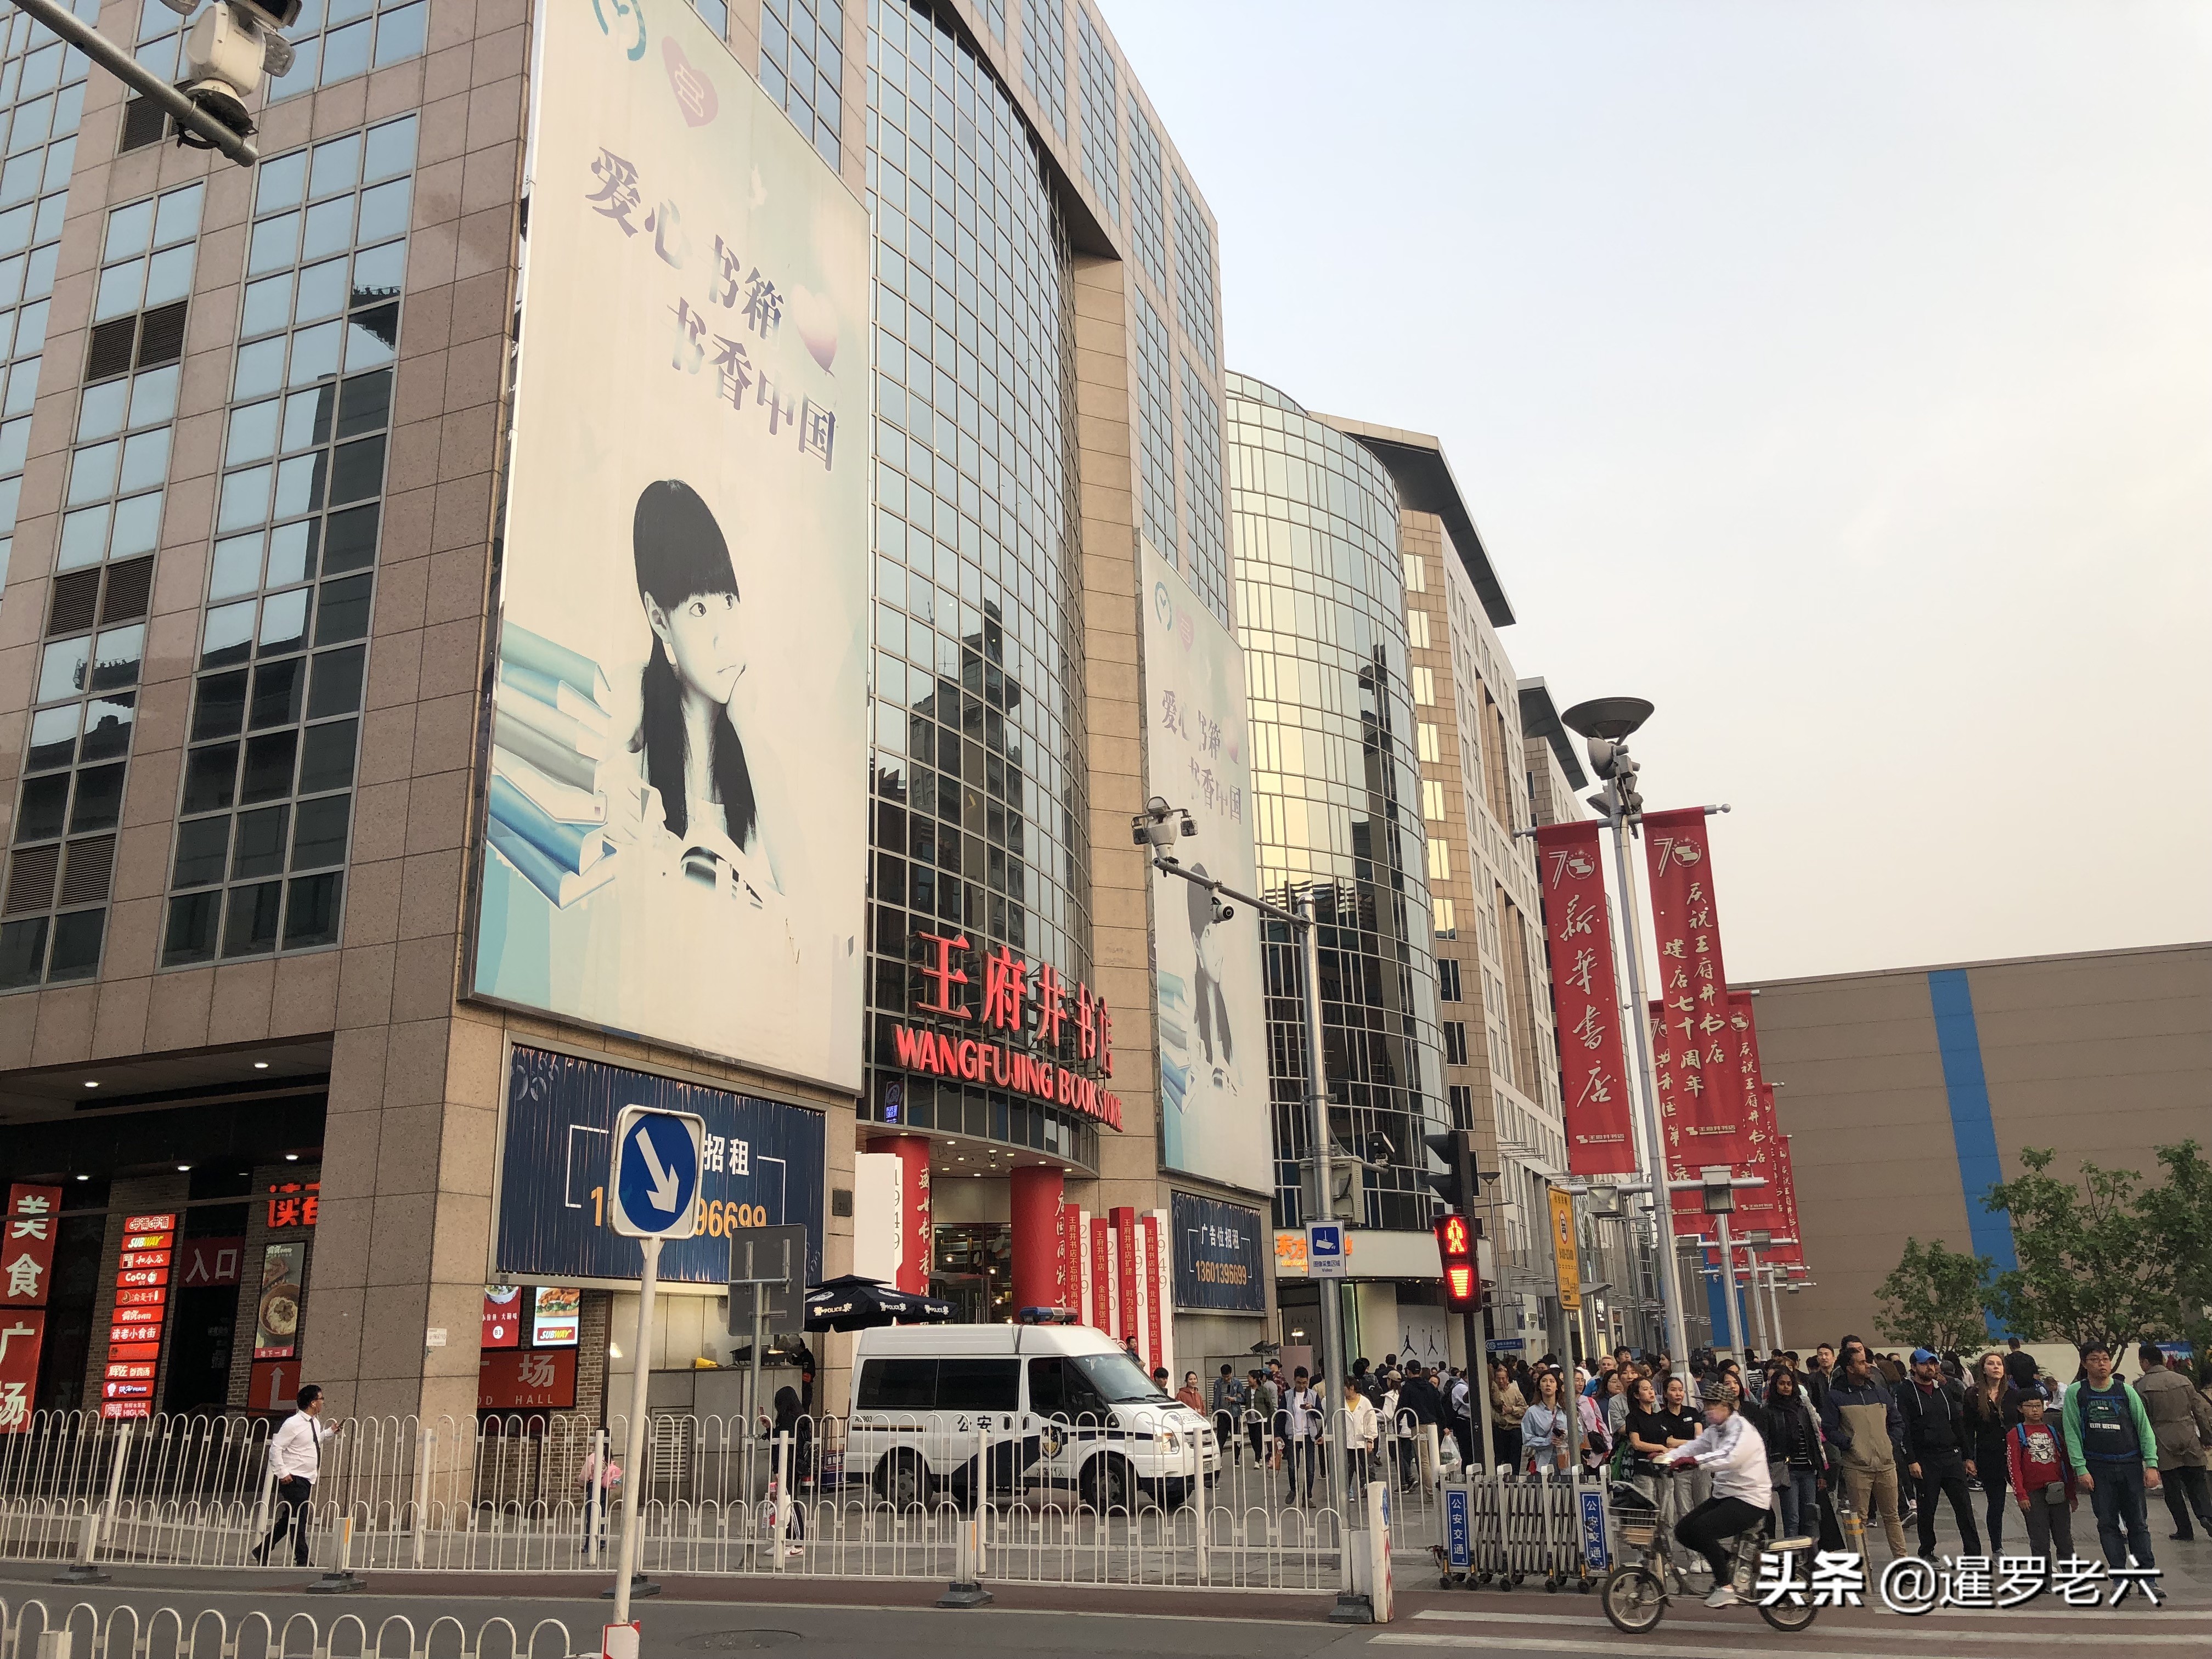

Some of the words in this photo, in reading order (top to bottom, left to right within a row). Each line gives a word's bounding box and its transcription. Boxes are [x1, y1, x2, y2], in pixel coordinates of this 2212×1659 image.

[1686, 882, 1725, 1064] 庆祝王府井书店
[914, 930, 1114, 1079] 王府井书店
[1662, 939, 1705, 1098] 建店七十周年
[891, 1023, 1054, 1099] WANGFUJING
[1057, 1066, 1124, 1133] BOOKSTORE
[127, 1235, 164, 1249] SUBWAY
[1201, 1223, 1240, 1250] 广告位招租
[185, 1247, 238, 1283] 入口
[1069, 1216, 1079, 1308] 王府井书店不忘初心再出
[1158, 1221, 1167, 1290] 1949
[125, 1272, 146, 1282] CoCo
[1195, 1260, 1248, 1286] 13601396699
[112, 1327, 156, 1340] 读者小食街
[540, 1329, 572, 1339] SUBWAY
[515, 1393, 554, 1405] HALL
[957, 1414, 992, 1434] 公安
[1451, 1498, 1464, 1555] 公安交通
